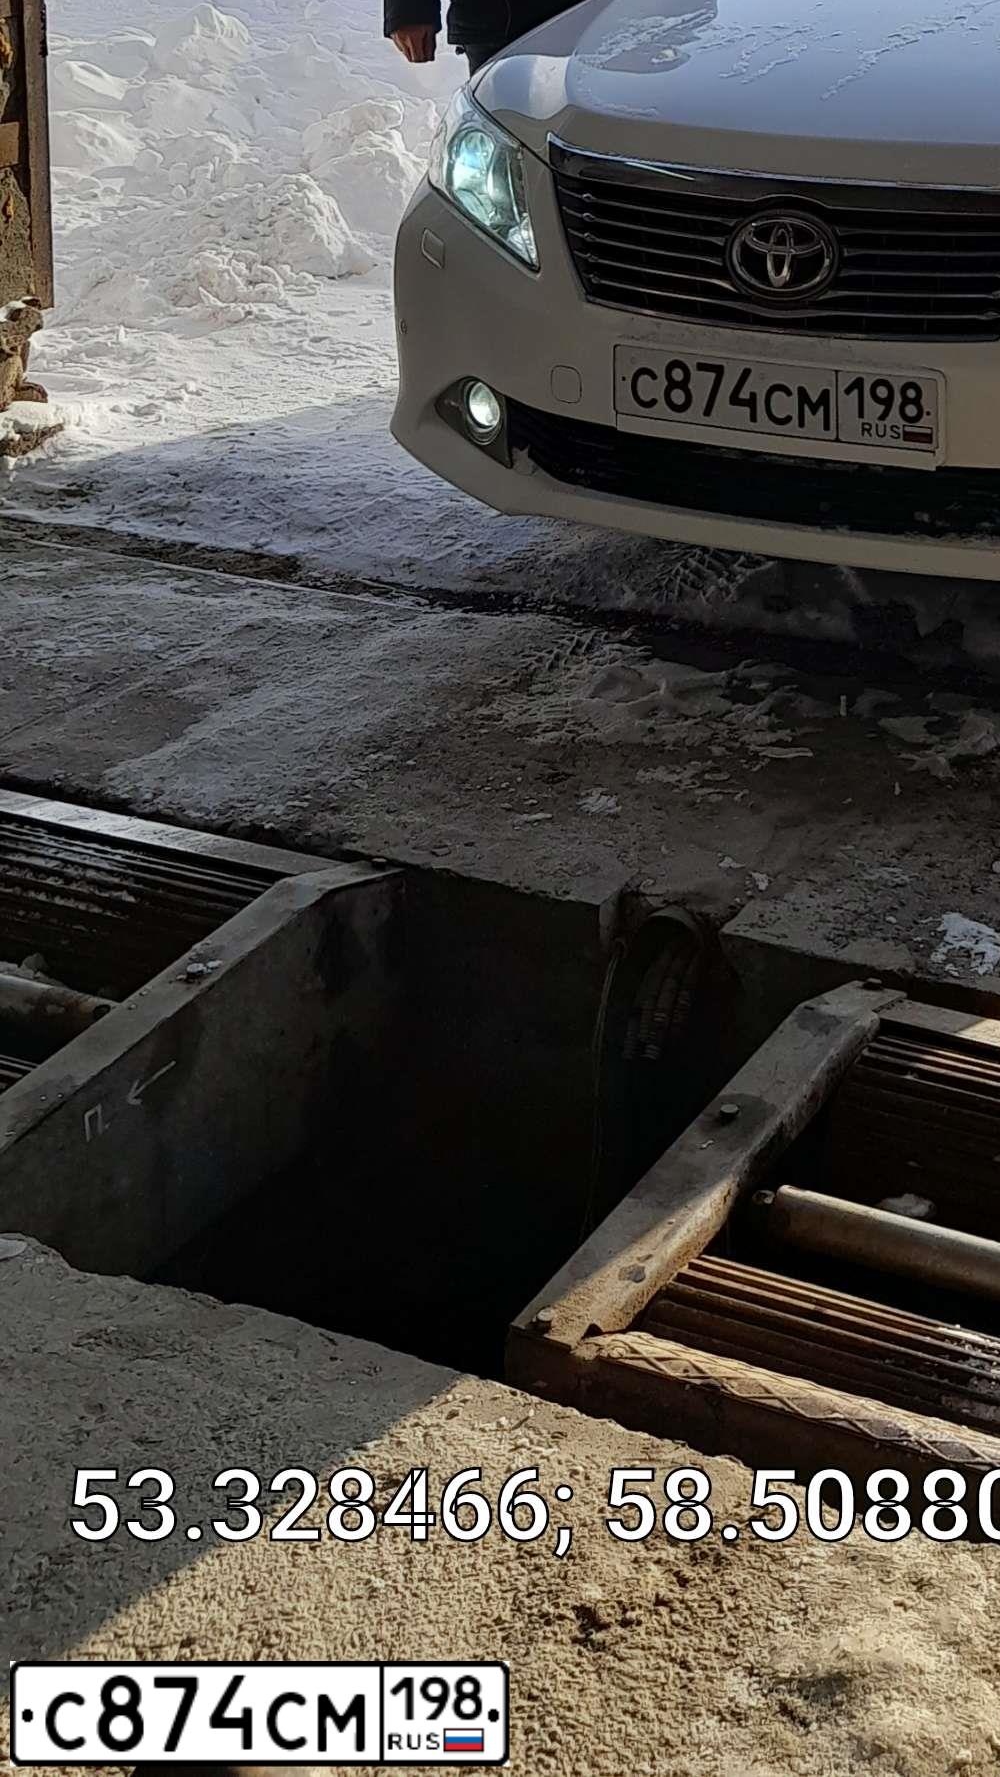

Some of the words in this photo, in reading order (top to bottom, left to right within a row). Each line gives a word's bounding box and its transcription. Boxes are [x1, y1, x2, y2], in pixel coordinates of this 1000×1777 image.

[630, 359, 831, 432] С874СМ
[843, 376, 924, 425] 198
[861, 421, 901, 440] RUS
